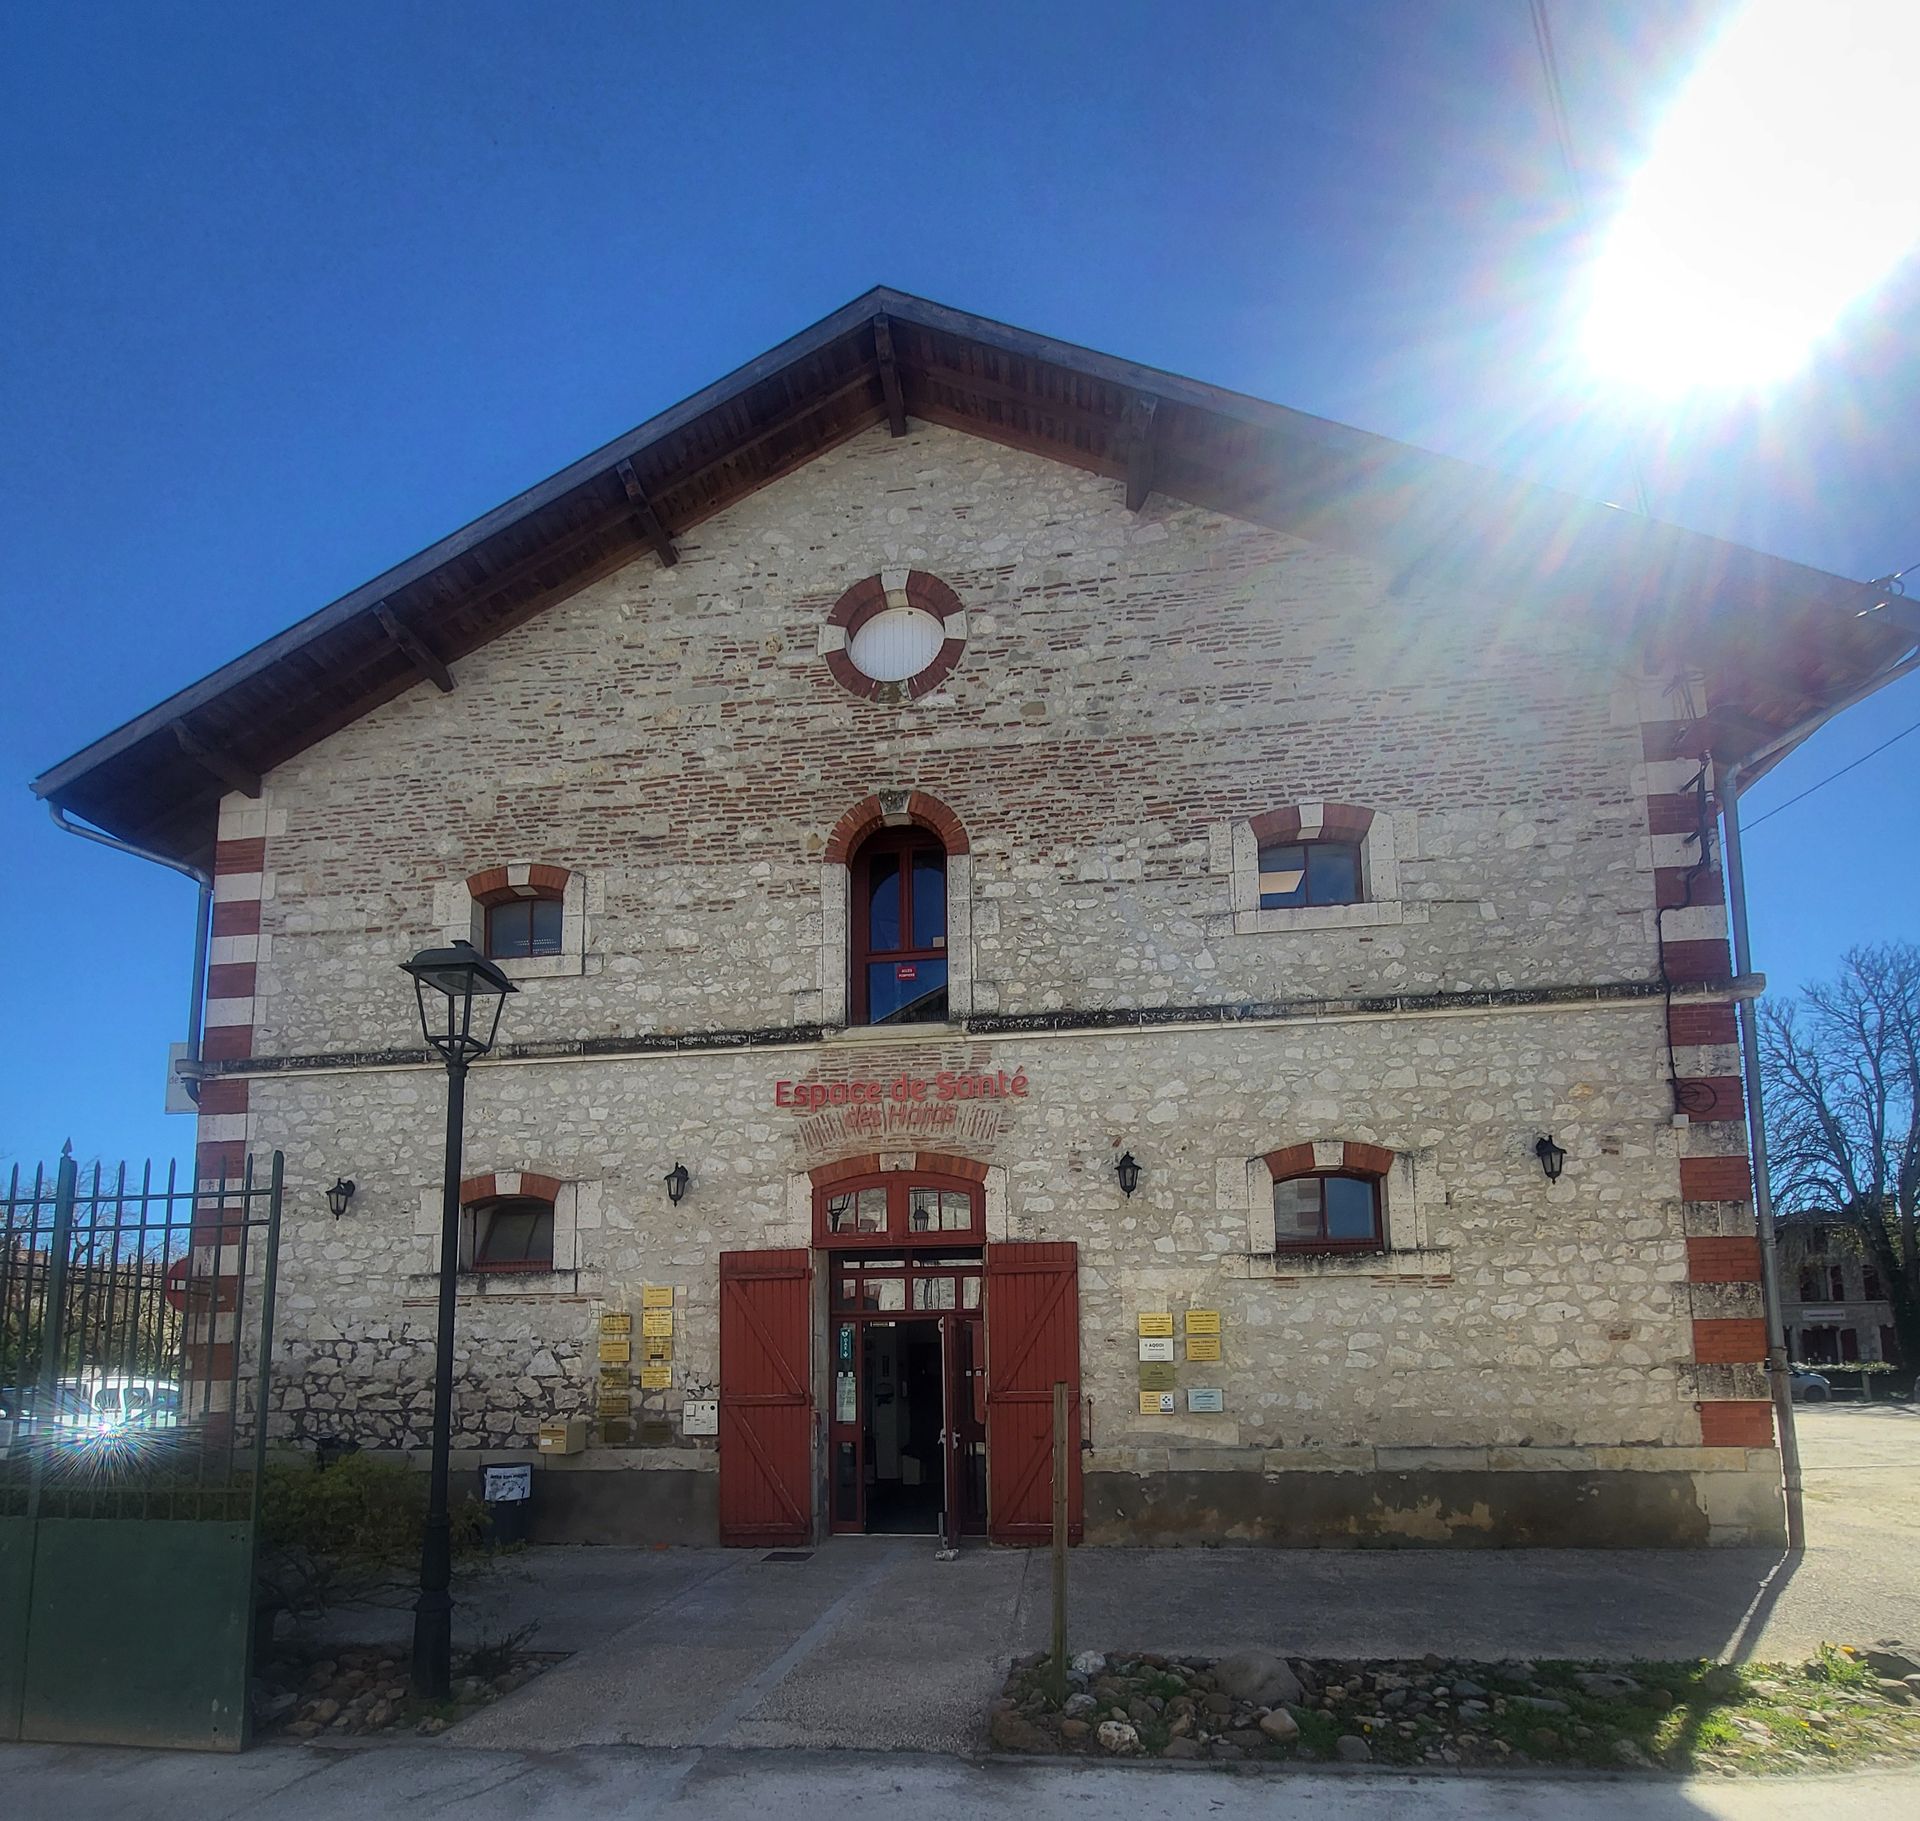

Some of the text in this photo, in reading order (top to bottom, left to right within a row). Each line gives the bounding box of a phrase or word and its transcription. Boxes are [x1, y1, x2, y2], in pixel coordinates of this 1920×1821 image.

[775, 1065, 1028, 1113] Espace de Santé
[844, 1105, 881, 1128] des
